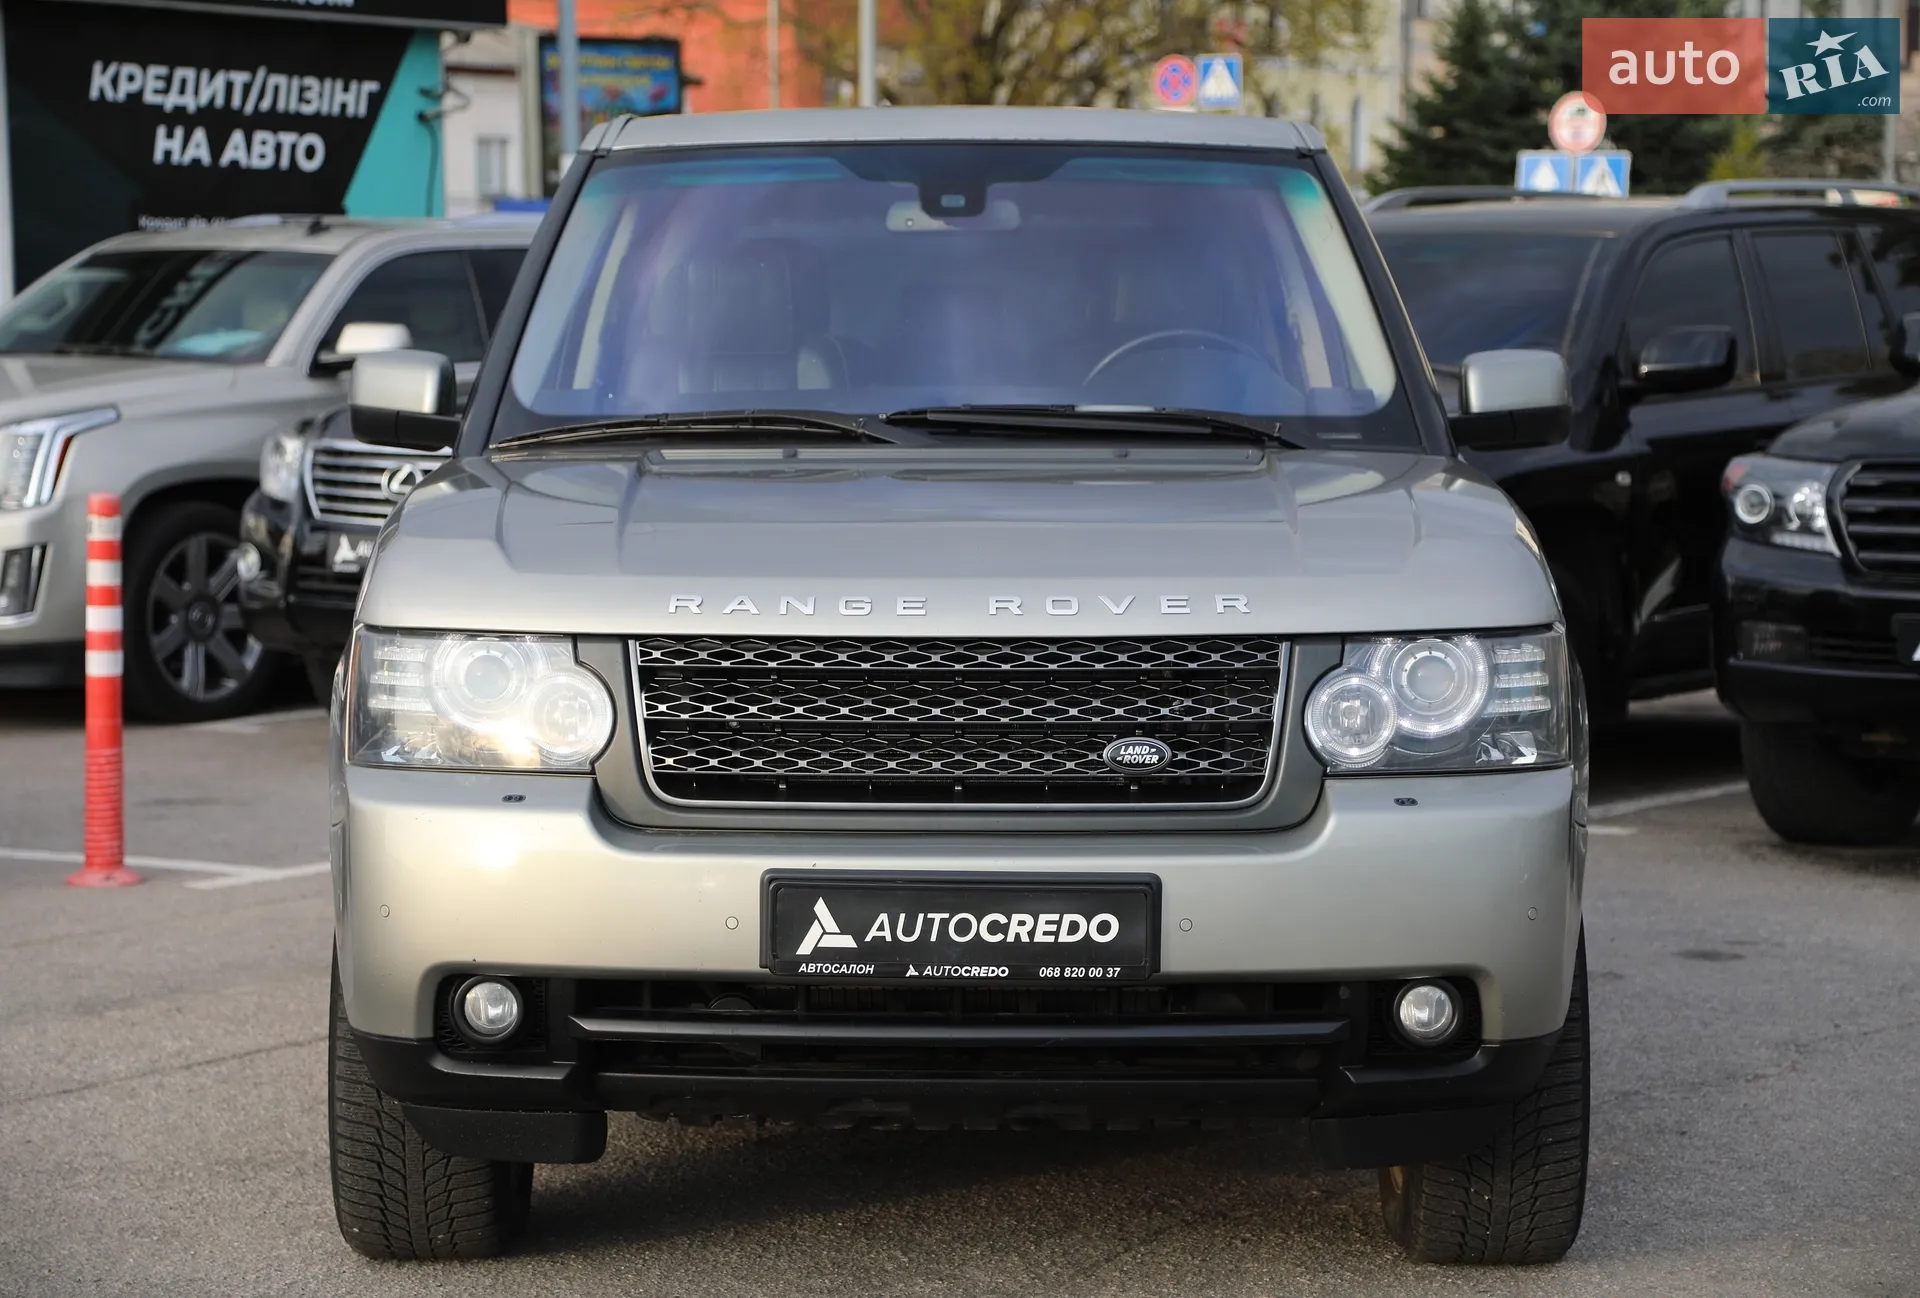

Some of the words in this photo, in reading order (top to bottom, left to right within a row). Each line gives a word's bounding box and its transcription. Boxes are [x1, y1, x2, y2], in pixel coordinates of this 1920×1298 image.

[89, 60, 381, 119] КРЕДИТ/ЛІЗІНГ
[153, 124, 213, 168] НА
[218, 127, 326, 173] АВТО
[668, 594, 928, 616] RANGE
[988, 594, 1251, 616] ROVER
[1120, 745, 1149, 754] LAND
[1122, 755, 1159, 764] ROVER
[864, 912, 1120, 943] AUTOCREDO
[798, 963, 875, 975] АВТОСАЛОН
[922, 965, 1009, 978] AUTOCREDO
[1038, 967, 1061, 978] 068
[1063, 967, 1086, 978] 820
[1088, 967, 1104, 979] 00
[1106, 967, 1121, 979] 37
